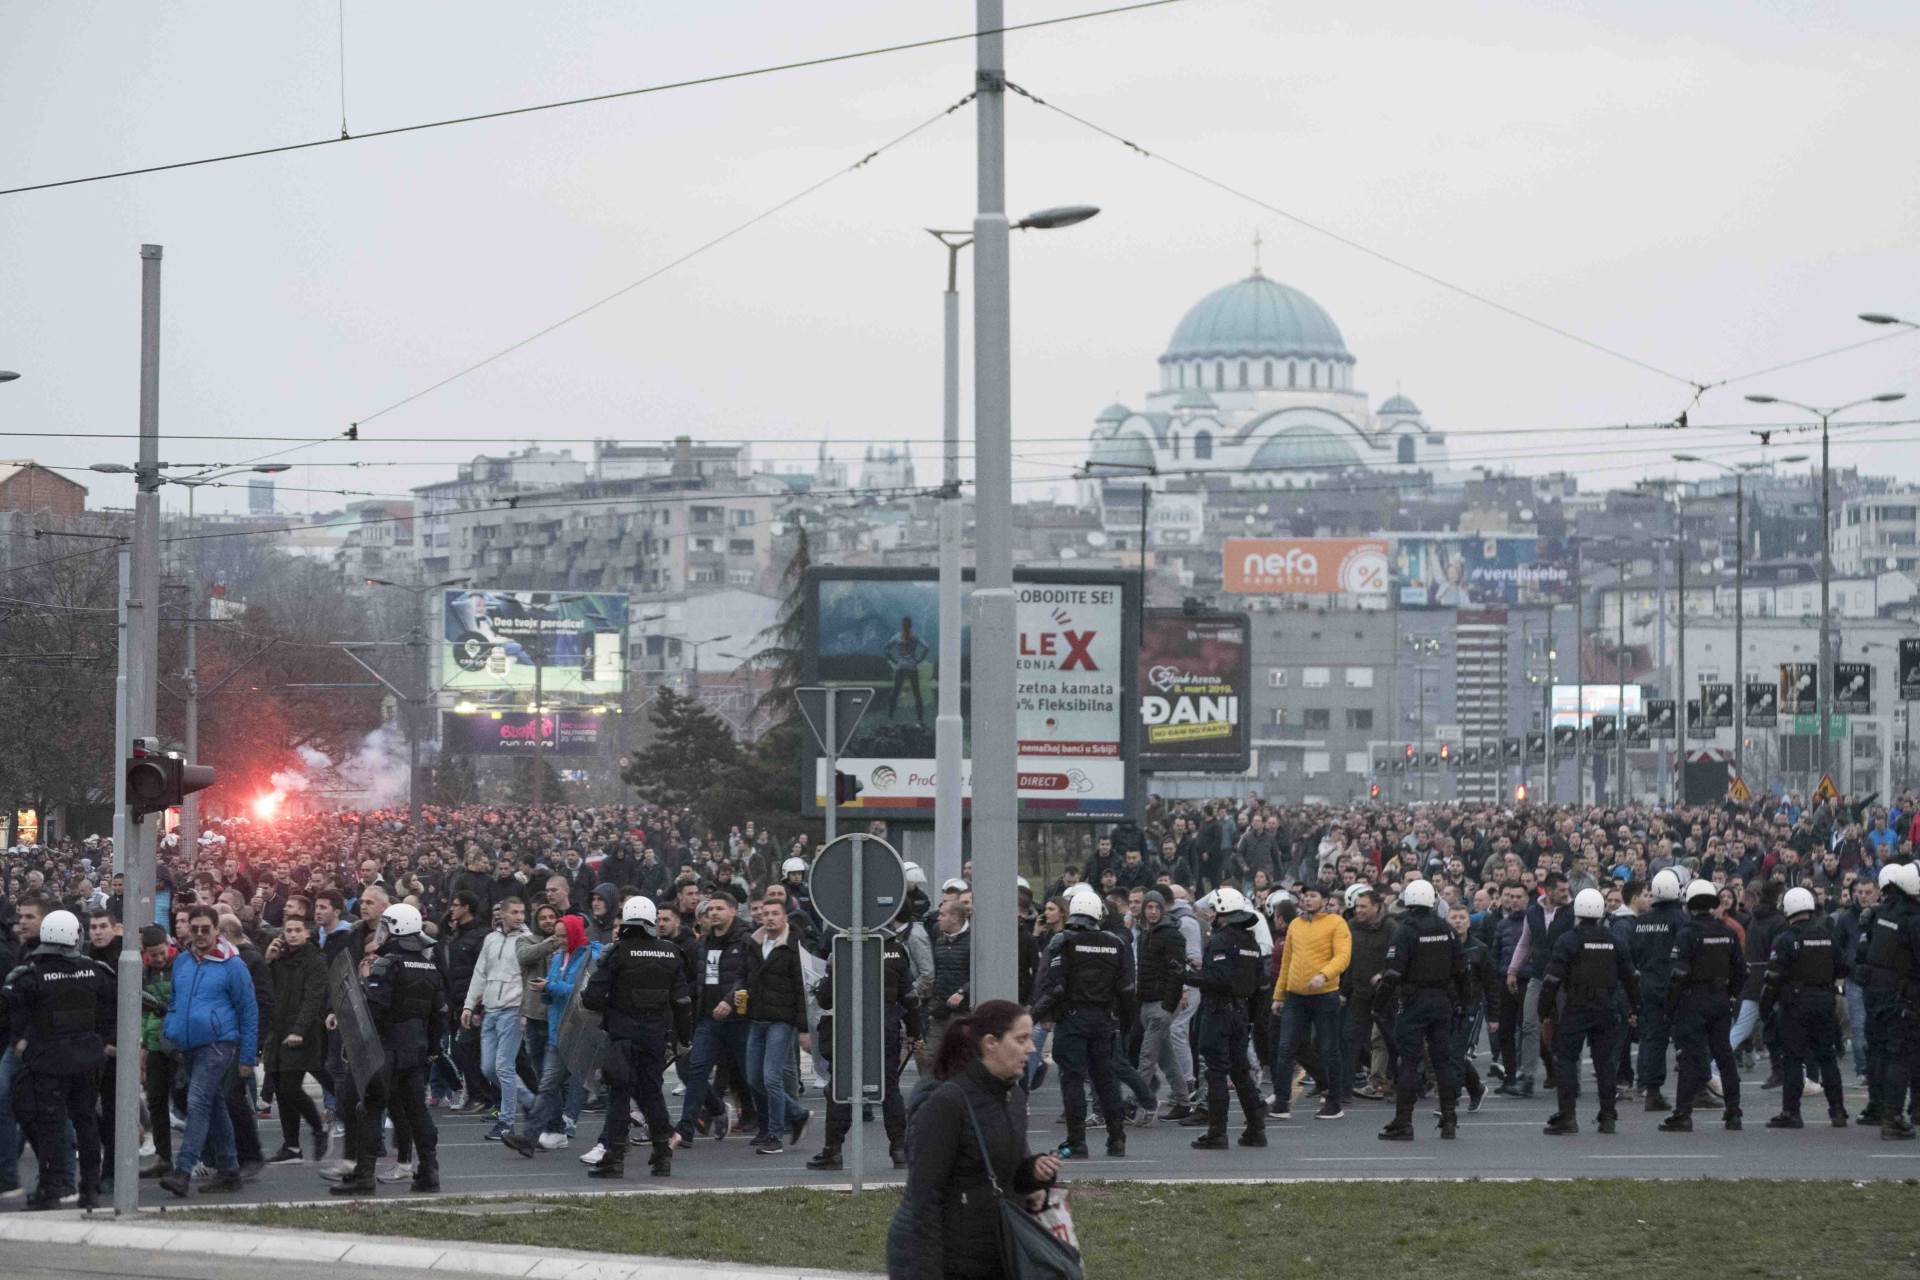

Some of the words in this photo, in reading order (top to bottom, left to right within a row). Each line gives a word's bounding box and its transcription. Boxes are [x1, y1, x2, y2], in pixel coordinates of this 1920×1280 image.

[1244, 549, 1318, 575] nefa
[1091, 591, 1114, 604] SE!
[494, 617, 513, 627] Deo
[1191, 675, 1221, 684] Arena
[1062, 682, 1113, 695] kamata
[1184, 685, 1206, 693] mart
[1208, 684, 1232, 693] 2019.
[1038, 699, 1113, 712] Fleksibilna
[1140, 696, 1238, 724] ĐANI
[1062, 744, 1084, 753] banci
[1020, 776, 1058, 787] DIRECT
[630, 950, 675, 959] ПОЛИЦИЈА
